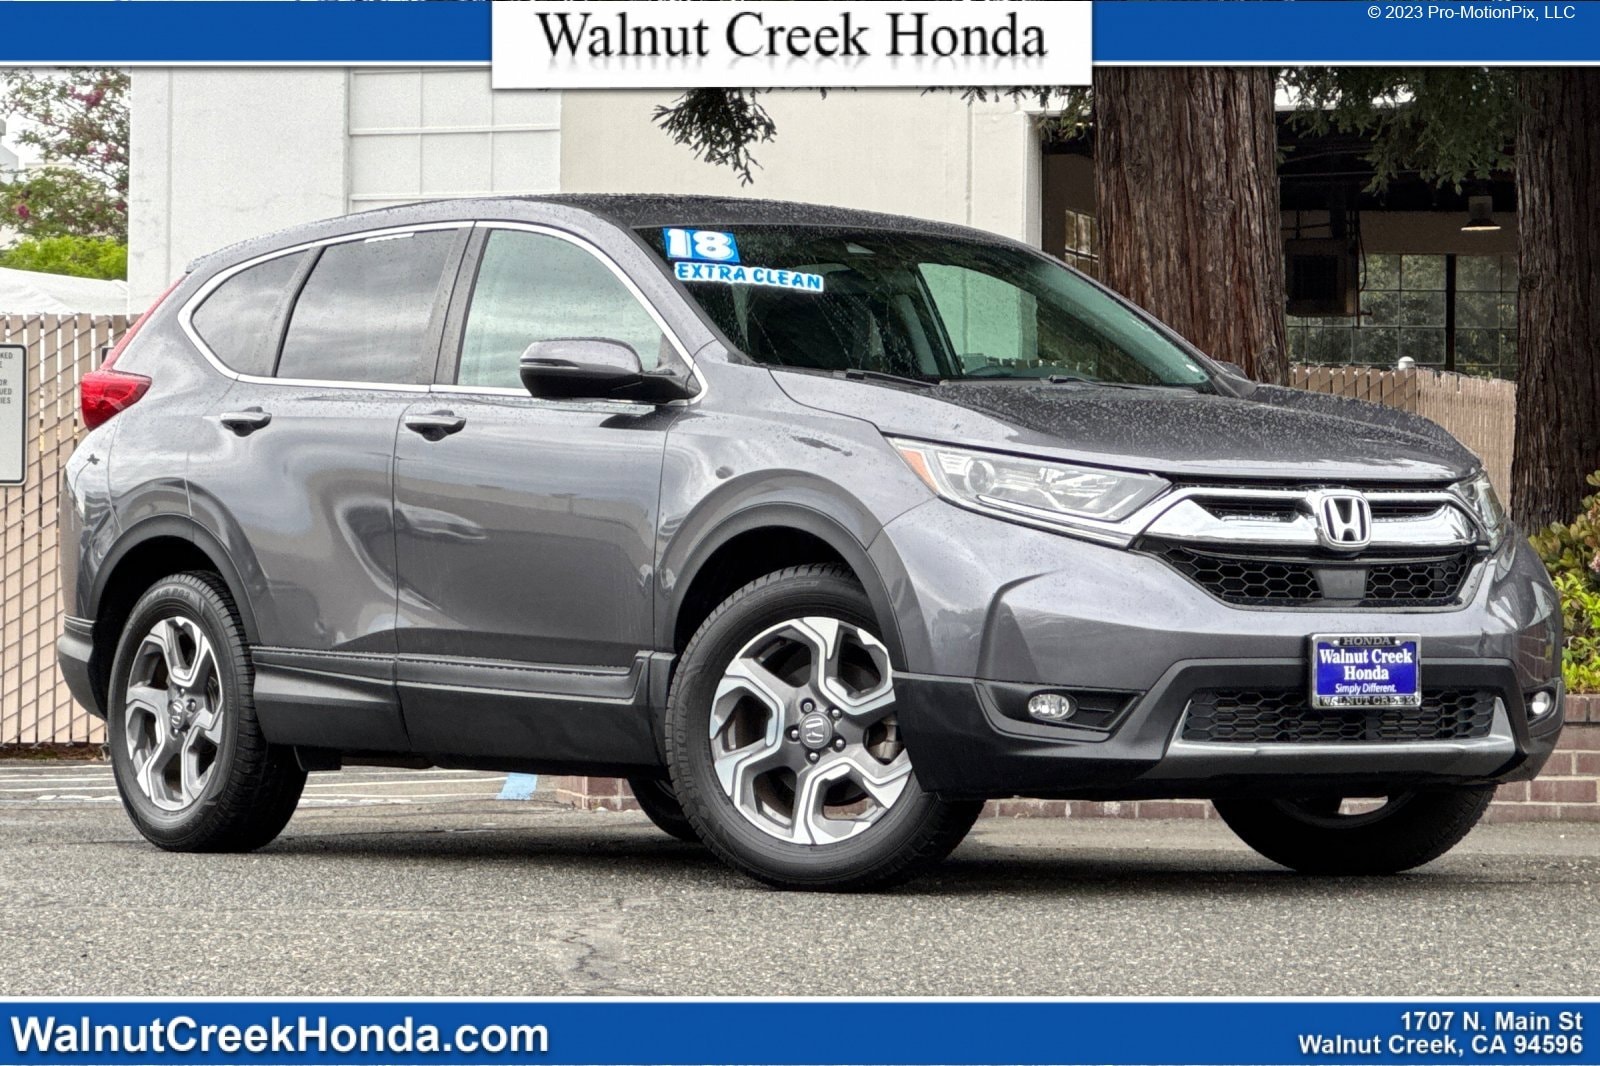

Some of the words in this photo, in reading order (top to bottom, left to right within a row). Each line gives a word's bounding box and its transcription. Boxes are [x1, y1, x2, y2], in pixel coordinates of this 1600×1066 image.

[667, 228, 735, 260] 18
[676, 263, 746, 281] EXTRA
[752, 268, 821, 289] CLEAN
[1342, 636, 1392, 646] HONDA
[1319, 648, 1369, 664] Walnut
[1371, 648, 1413, 664] Creek
[1343, 665, 1390, 680] Honda
[1335, 683, 1361, 695] Simply
[1362, 683, 1397, 693] Different.
[1372, 696, 1414, 706] CREEK
